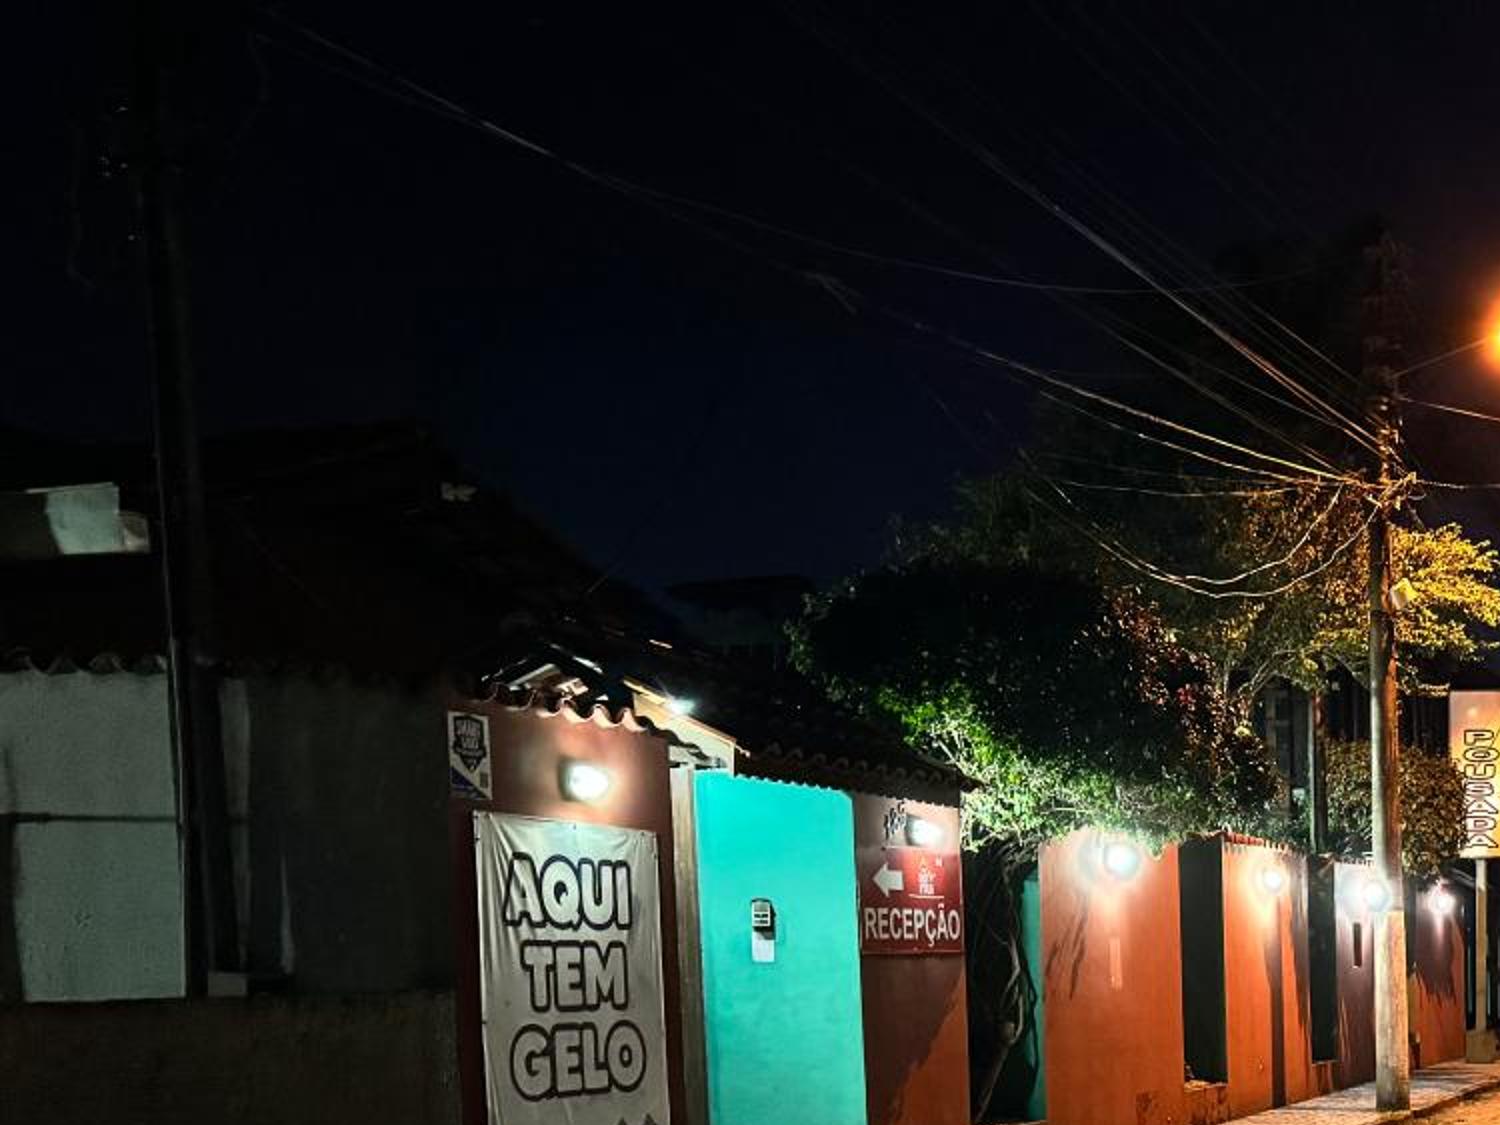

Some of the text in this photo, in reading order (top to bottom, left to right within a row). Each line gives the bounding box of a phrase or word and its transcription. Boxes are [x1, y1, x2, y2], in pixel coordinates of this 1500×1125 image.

[1462, 729, 1500, 848] POUSADA
[503, 851, 632, 931] AQUI
[863, 903, 961, 948] RECEPÇÃO
[520, 940, 629, 1013] TEM
[509, 1020, 646, 1102] GELO
